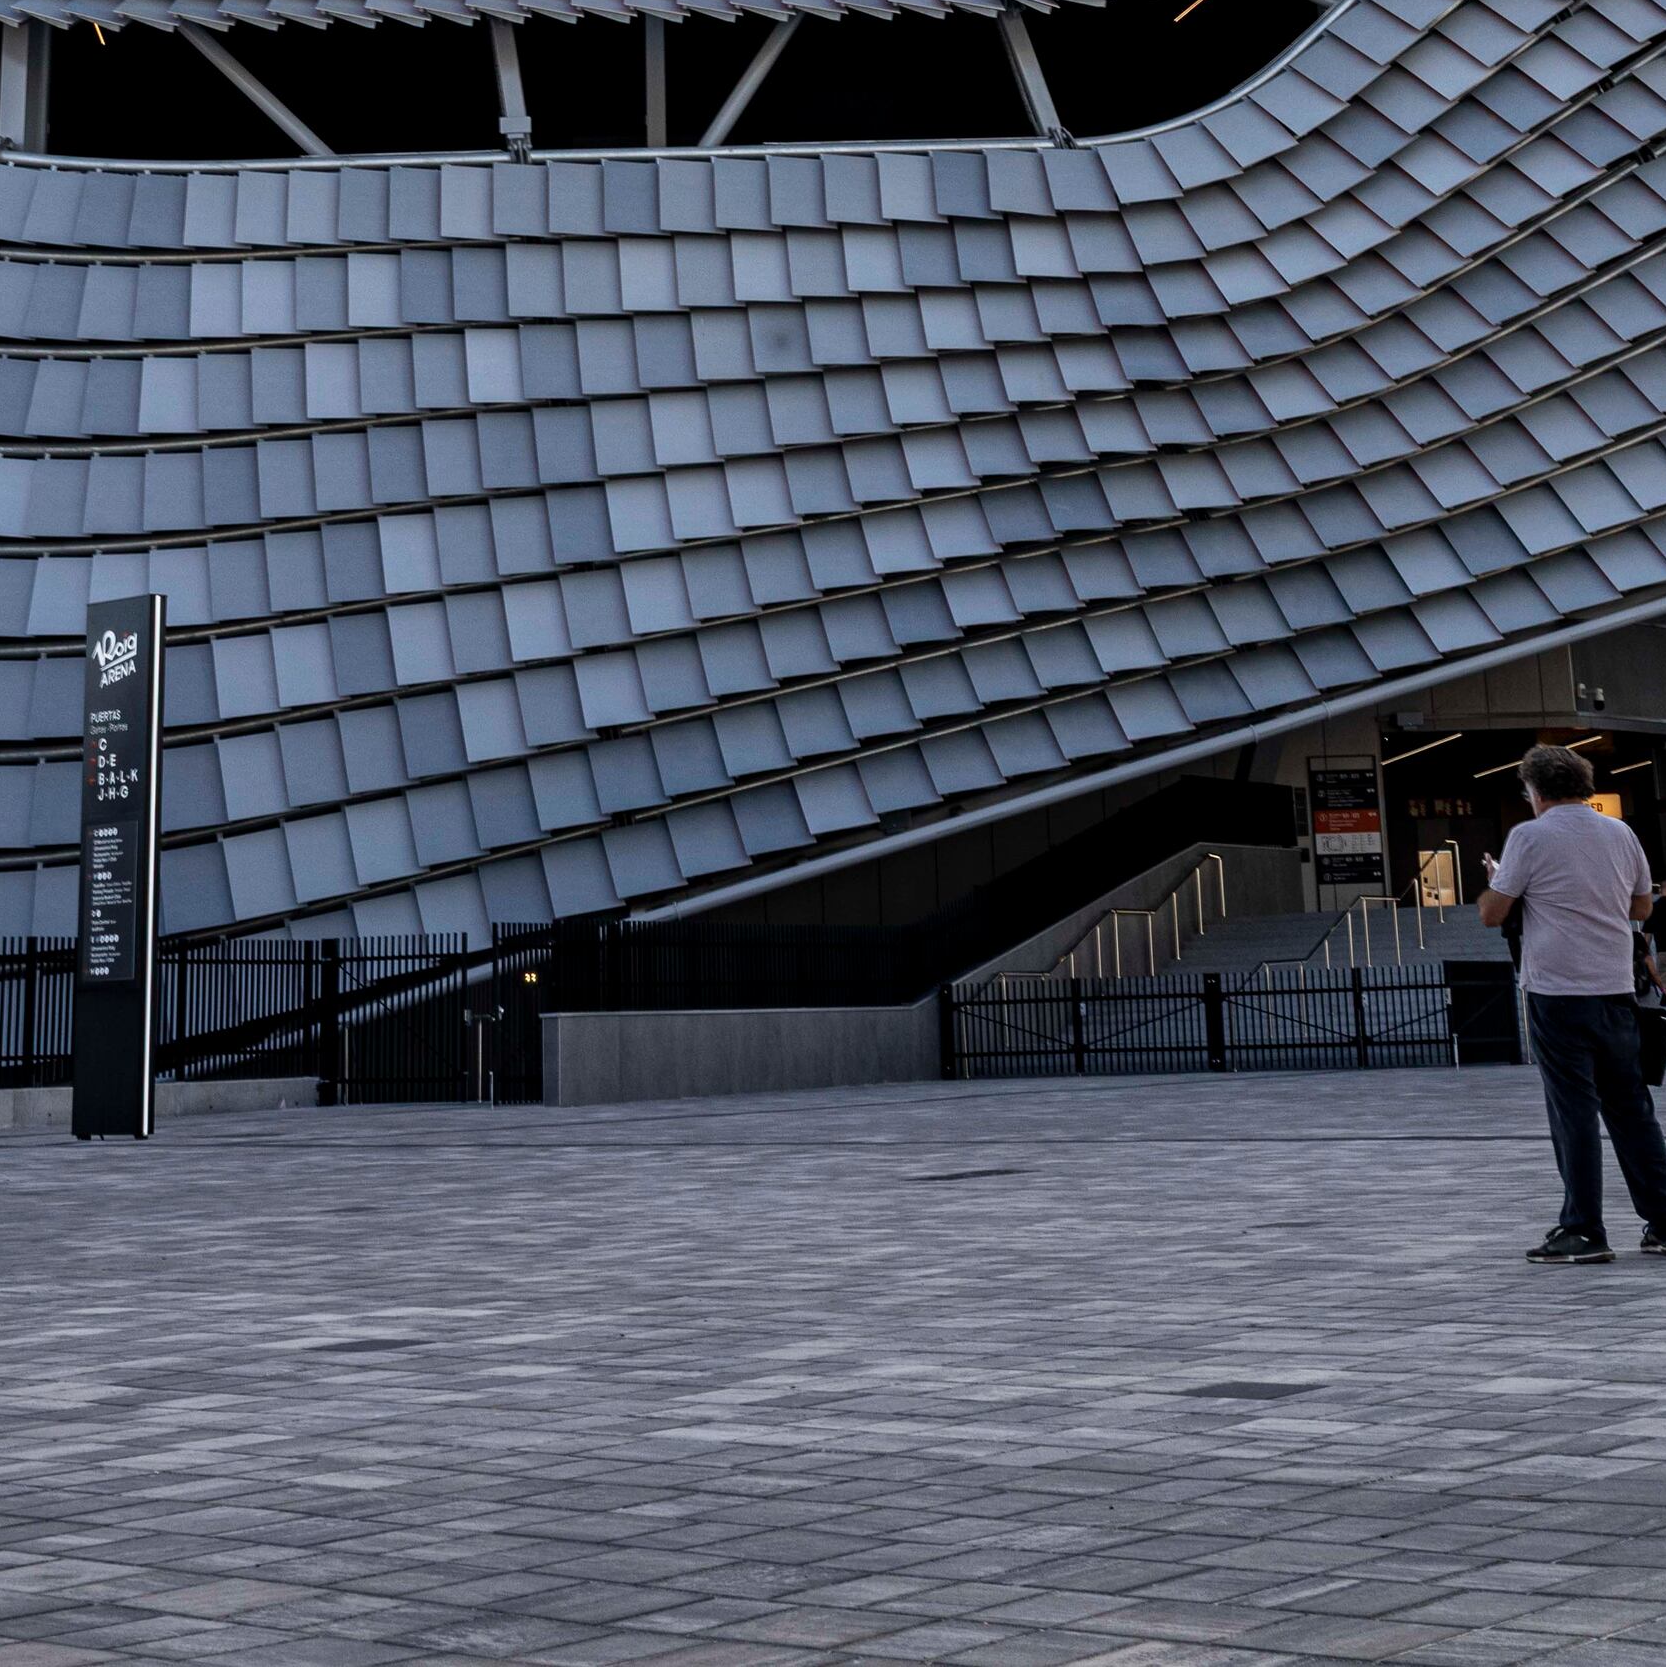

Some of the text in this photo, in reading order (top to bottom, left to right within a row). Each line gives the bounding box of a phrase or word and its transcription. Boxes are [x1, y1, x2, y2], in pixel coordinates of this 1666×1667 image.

[91, 629, 138, 670] Roig
[99, 659, 137, 689] ARENA
[90, 709, 122, 724] PUERTAS
[98, 737, 108, 751] C
